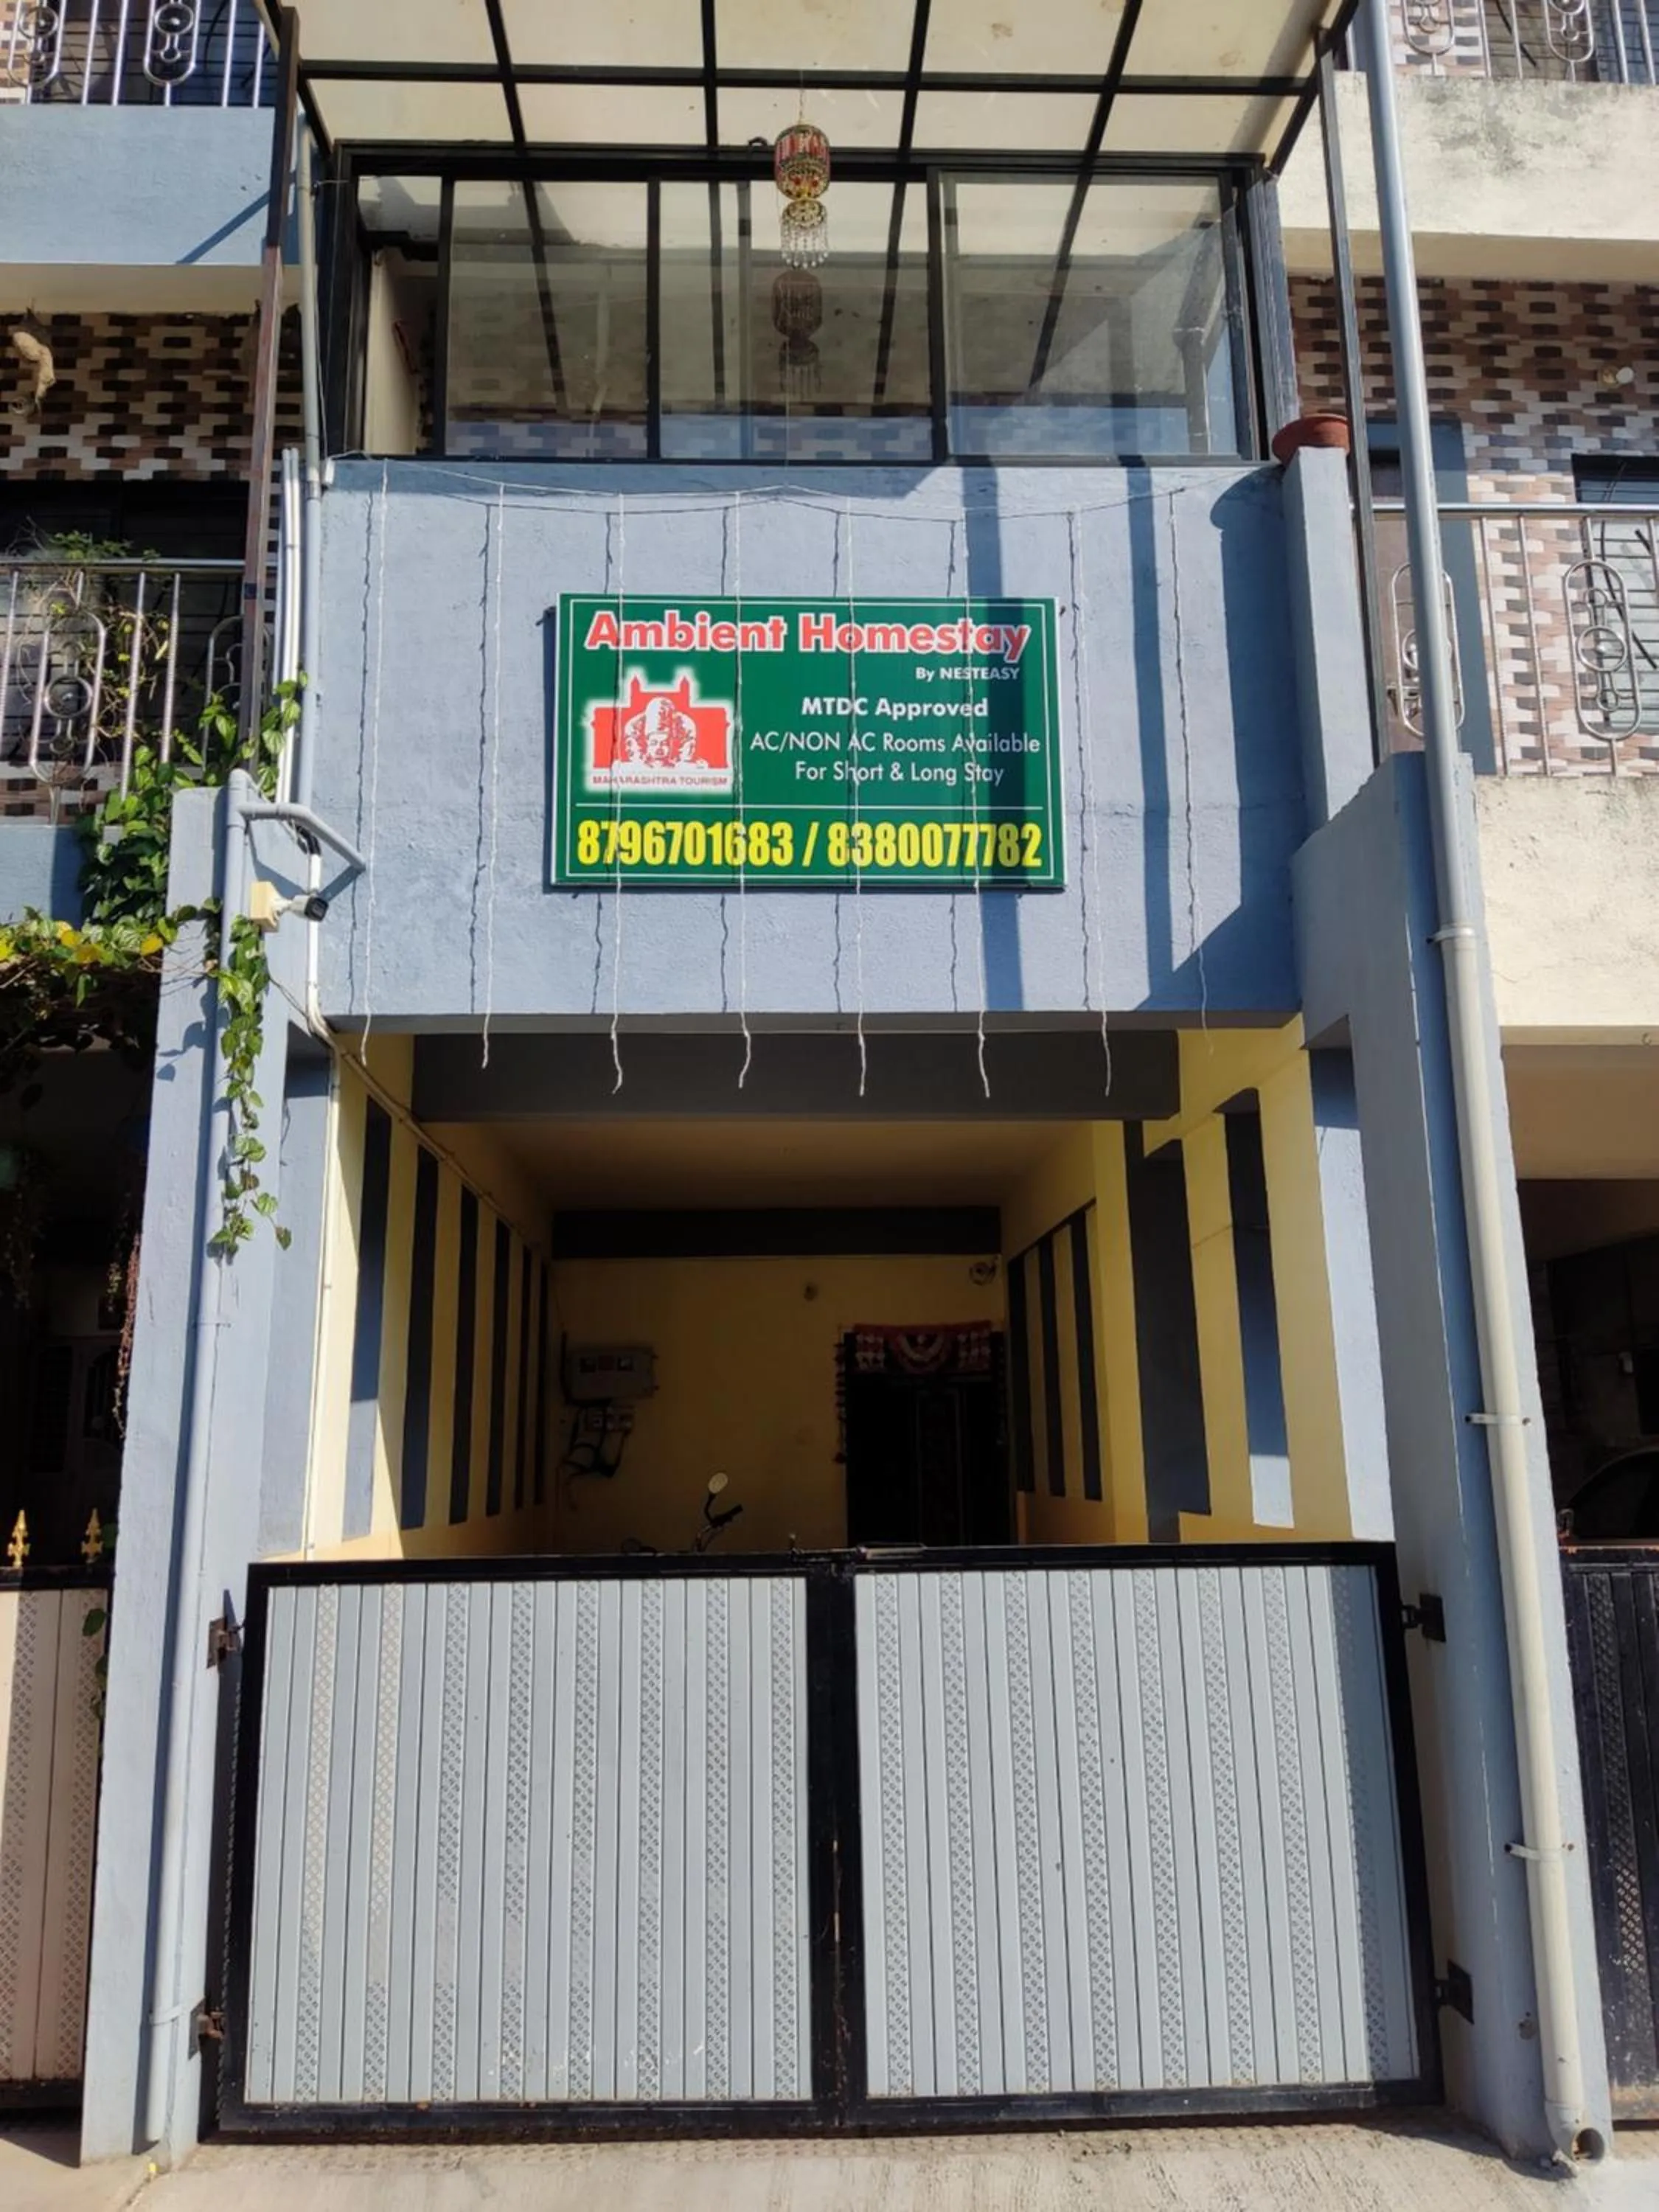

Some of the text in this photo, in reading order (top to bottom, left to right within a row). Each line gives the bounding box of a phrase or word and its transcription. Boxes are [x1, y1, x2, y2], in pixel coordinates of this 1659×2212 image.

[584, 610, 1031, 662] Ambient Homestay
[916, 667, 1020, 682] By NESTEASY
[801, 697, 989, 720] MTDC Approved
[750, 731, 1040, 753] AC/NON AC Rooms Available
[680, 776, 728, 786] TOURISM
[795, 761, 1005, 786] For Short & Long Stay
[577, 819, 1043, 868] 8796701683 / 8380077782
